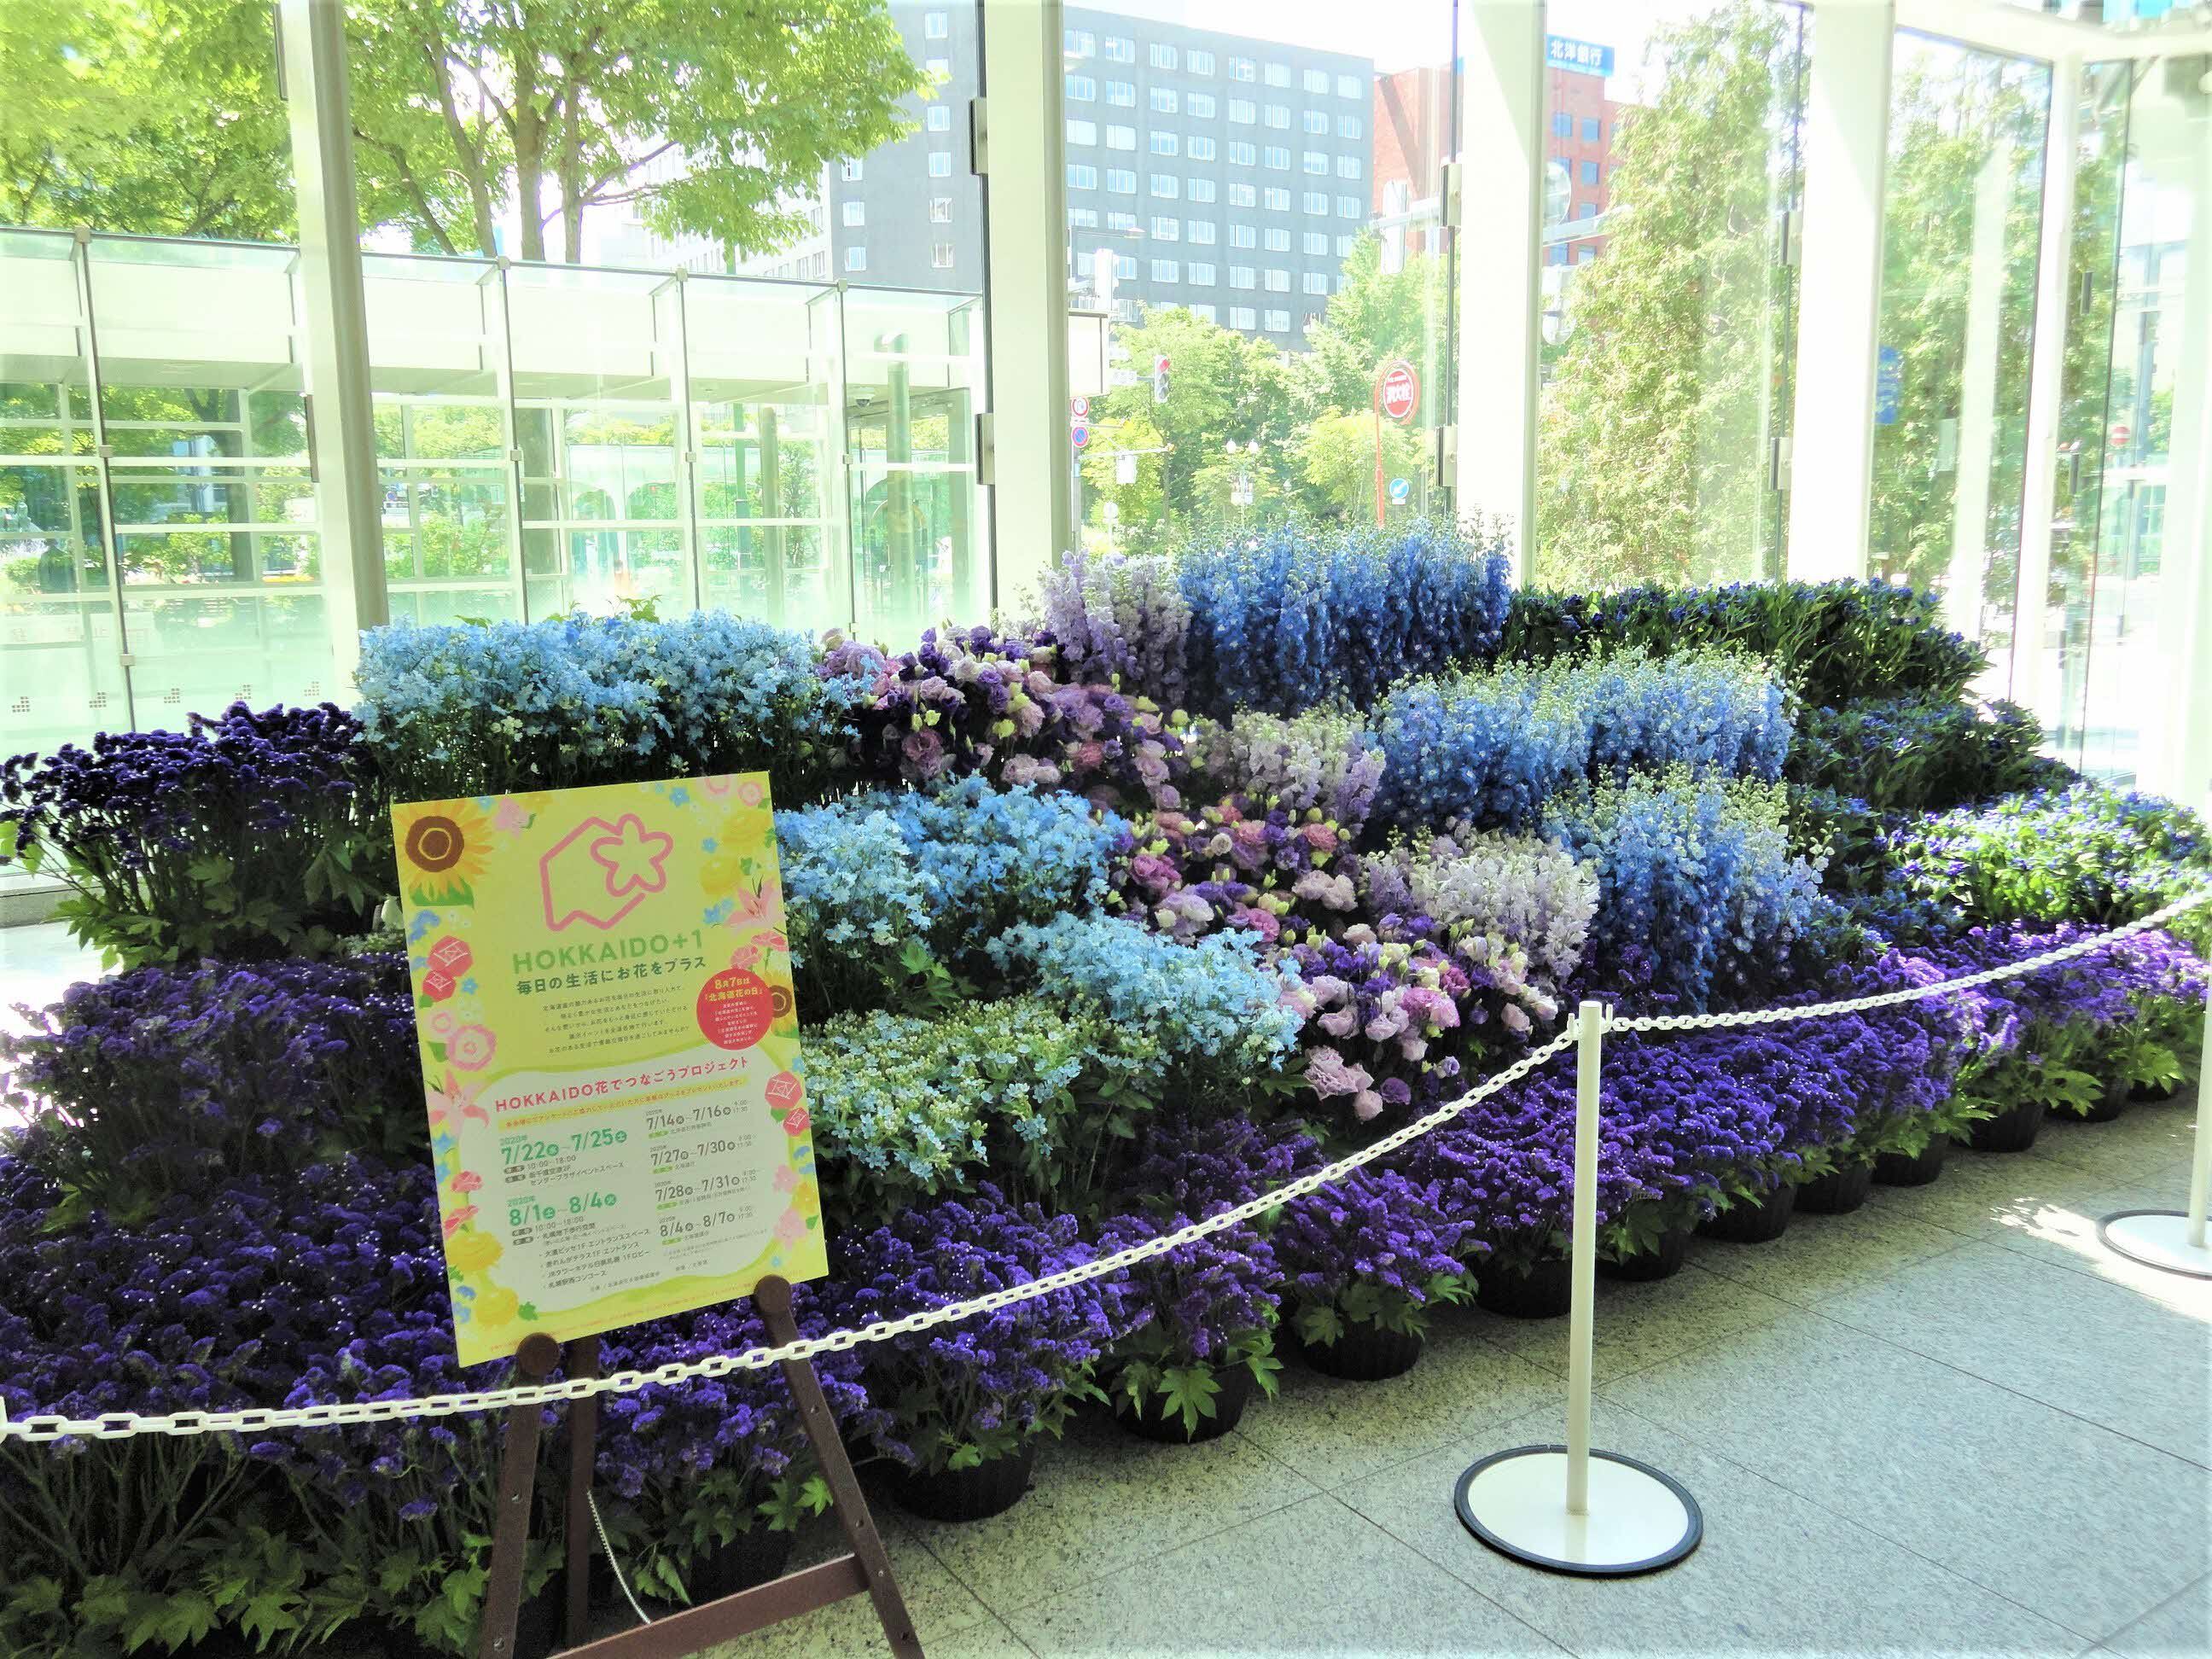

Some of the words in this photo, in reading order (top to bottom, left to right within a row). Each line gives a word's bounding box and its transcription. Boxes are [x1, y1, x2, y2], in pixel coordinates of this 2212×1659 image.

[1550, 39, 1603, 67] 北洋銀行
[512, 928, 703, 975] HOKKAIDO+1
[516, 956, 707, 996] 毎日の生活にお花をプラス
[495, 1056, 748, 1113] HOKKAIDO花でつなごうプロジェクト
